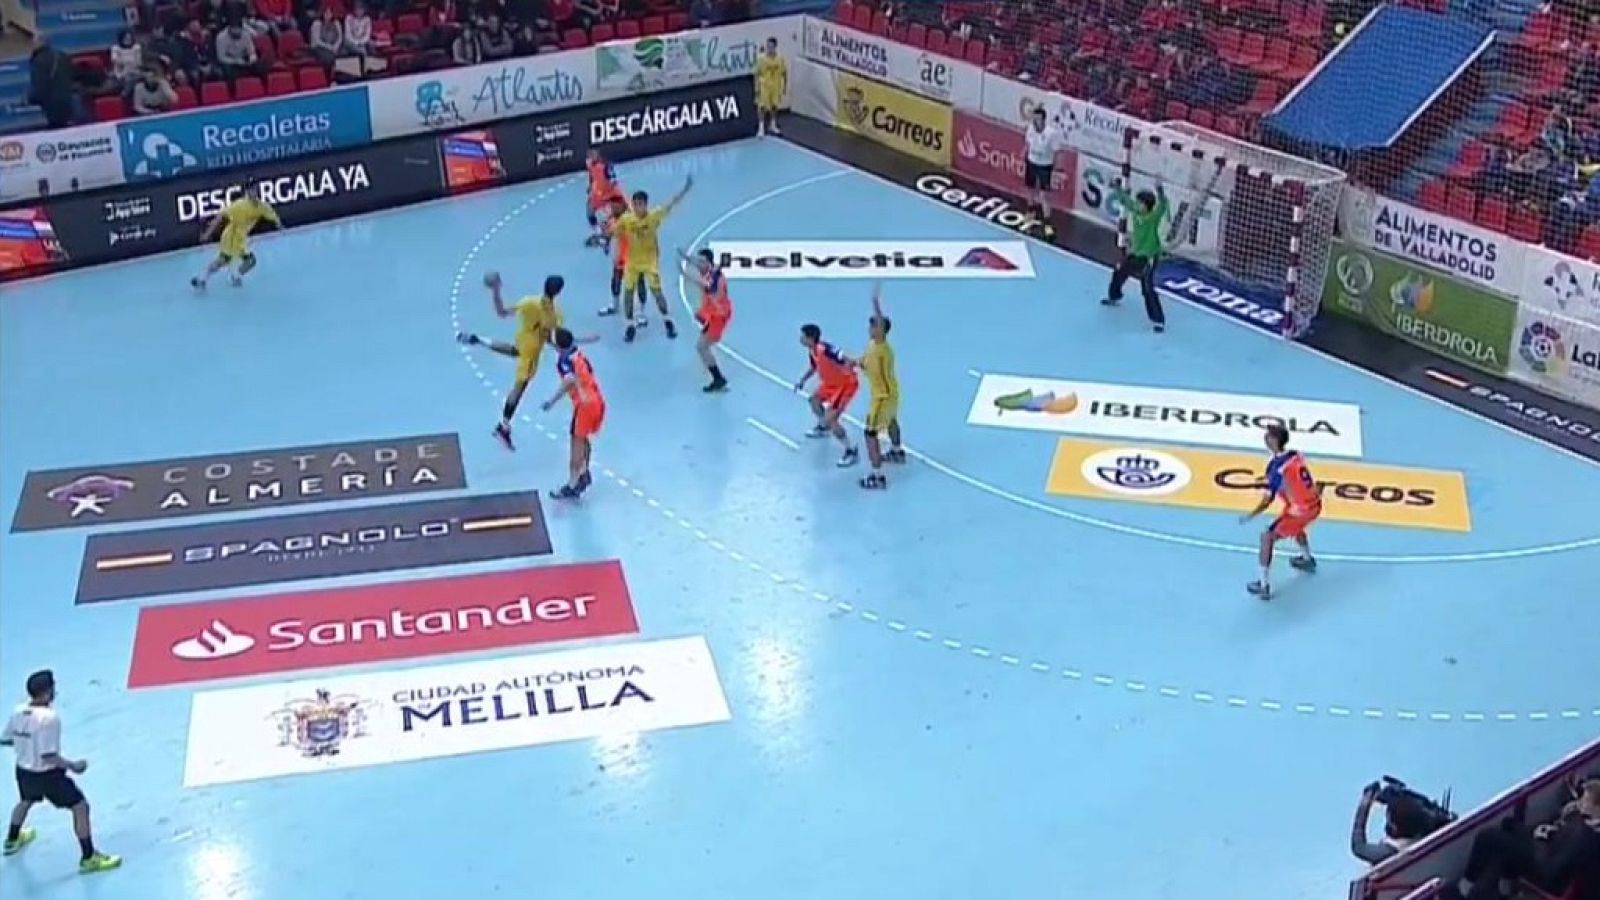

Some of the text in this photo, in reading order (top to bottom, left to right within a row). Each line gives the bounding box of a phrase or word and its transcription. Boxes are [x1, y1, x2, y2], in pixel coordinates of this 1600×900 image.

[821, 28, 887, 62] ALIMENTOS
[472, 66, 583, 114] Atlantis
[203, 111, 331, 149] Recoletas
[590, 100, 713, 145] DESCÁRGALA
[716, 95, 740, 120] YA
[872, 105, 944, 151] Correos
[236, 137, 332, 164] HOSPITALARIA
[979, 140, 1067, 190] Santaer
[177, 163, 370, 222] DESCRGALA YA
[916, 174, 1042, 231] Gerflor
[1374, 229, 1496, 281] DE VALLADOLID
[1376, 205, 1497, 262] ALIMENTOS
[720, 252, 944, 268] helvetia
[1396, 312, 1499, 364] IBERDROLA
[1089, 401, 1340, 436] IBERDROLA
[160, 465, 438, 509] ALMERÍA
[184, 522, 449, 562] SPAGNOLO
[268, 593, 597, 651] Santander
[392, 663, 646, 703] CIUDAD AUTÓNOMA
[400, 680, 656, 732] MELILLA
